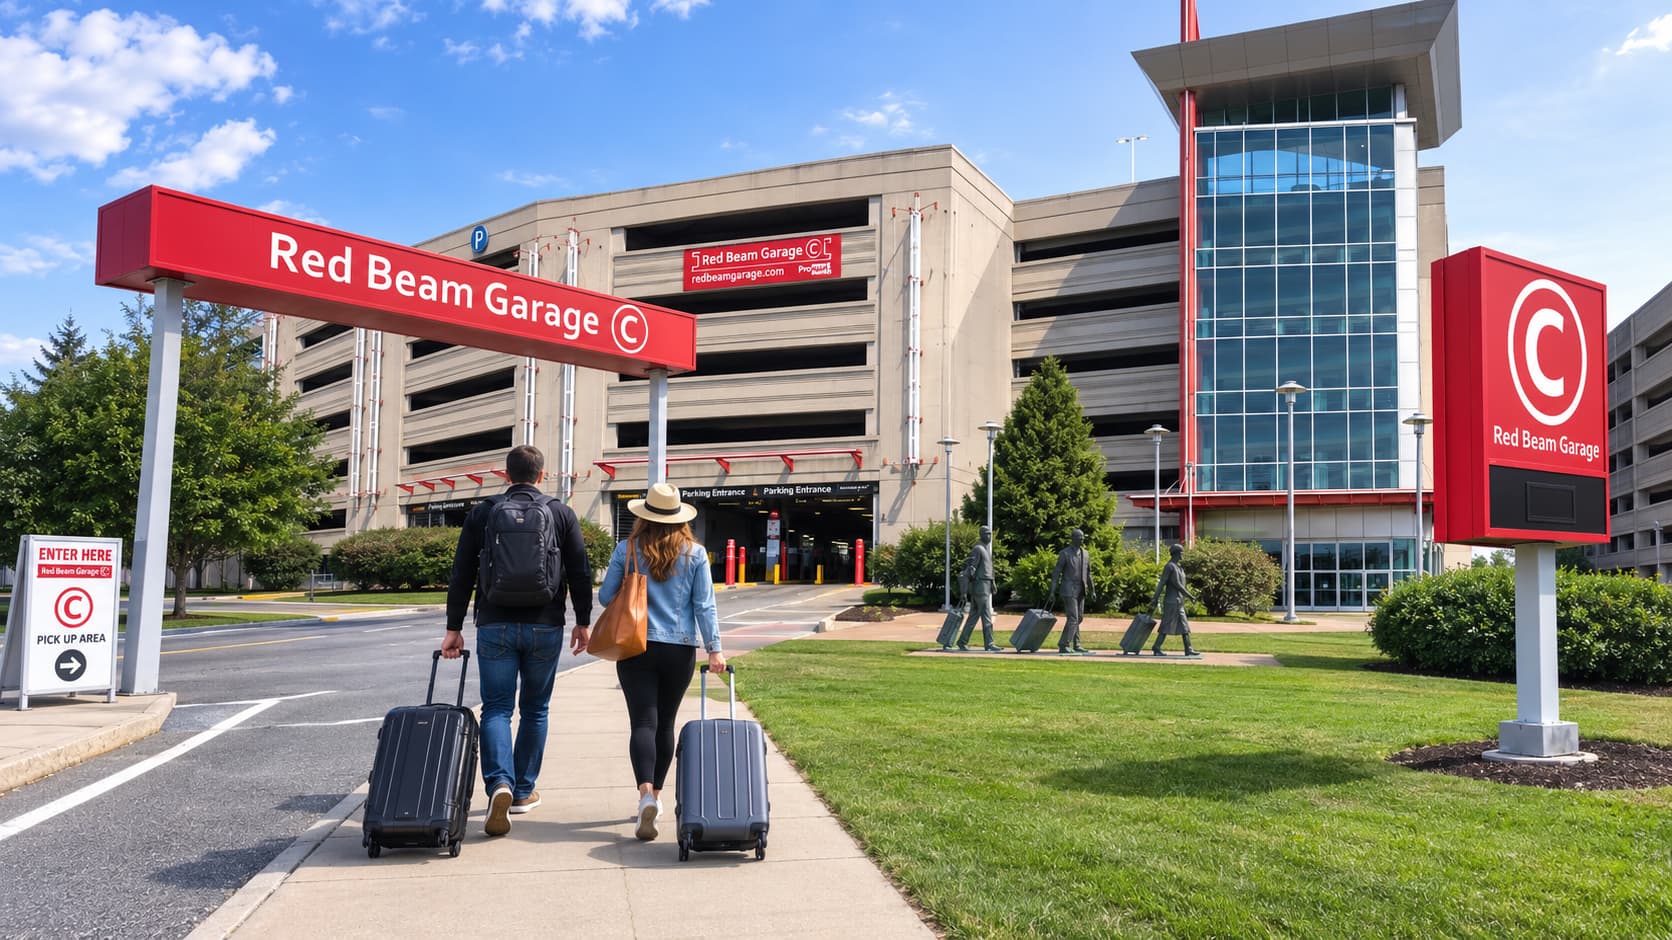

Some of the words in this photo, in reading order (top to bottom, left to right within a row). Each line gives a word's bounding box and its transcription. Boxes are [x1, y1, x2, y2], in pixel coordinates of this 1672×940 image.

[475, 230, 484, 250] P
[702, 252, 723, 265] Red
[726, 250, 758, 262] Beam
[761, 247, 803, 260] Garage
[692, 268, 784, 284] redbeamgarage.com
[270, 231, 352, 284] Red
[367, 253, 473, 309] Beam
[484, 282, 599, 340] Garage
[1494, 425, 1519, 447] Red
[1522, 430, 1557, 453] Beam
[1559, 436, 1600, 462] Garage
[682, 489, 711, 498] Parking
[763, 486, 794, 496] Parking
[795, 485, 832, 494] Entrance
[39, 547, 78, 561] ENTER
[81, 548, 112, 562] HERE
[41, 566, 54, 575] Red
[55, 567, 75, 575] Beam
[76, 568, 99, 577] Garage
[37, 633, 61, 645] PICK
[64, 634, 78, 644] UP
[79, 633, 106, 643] AREA
